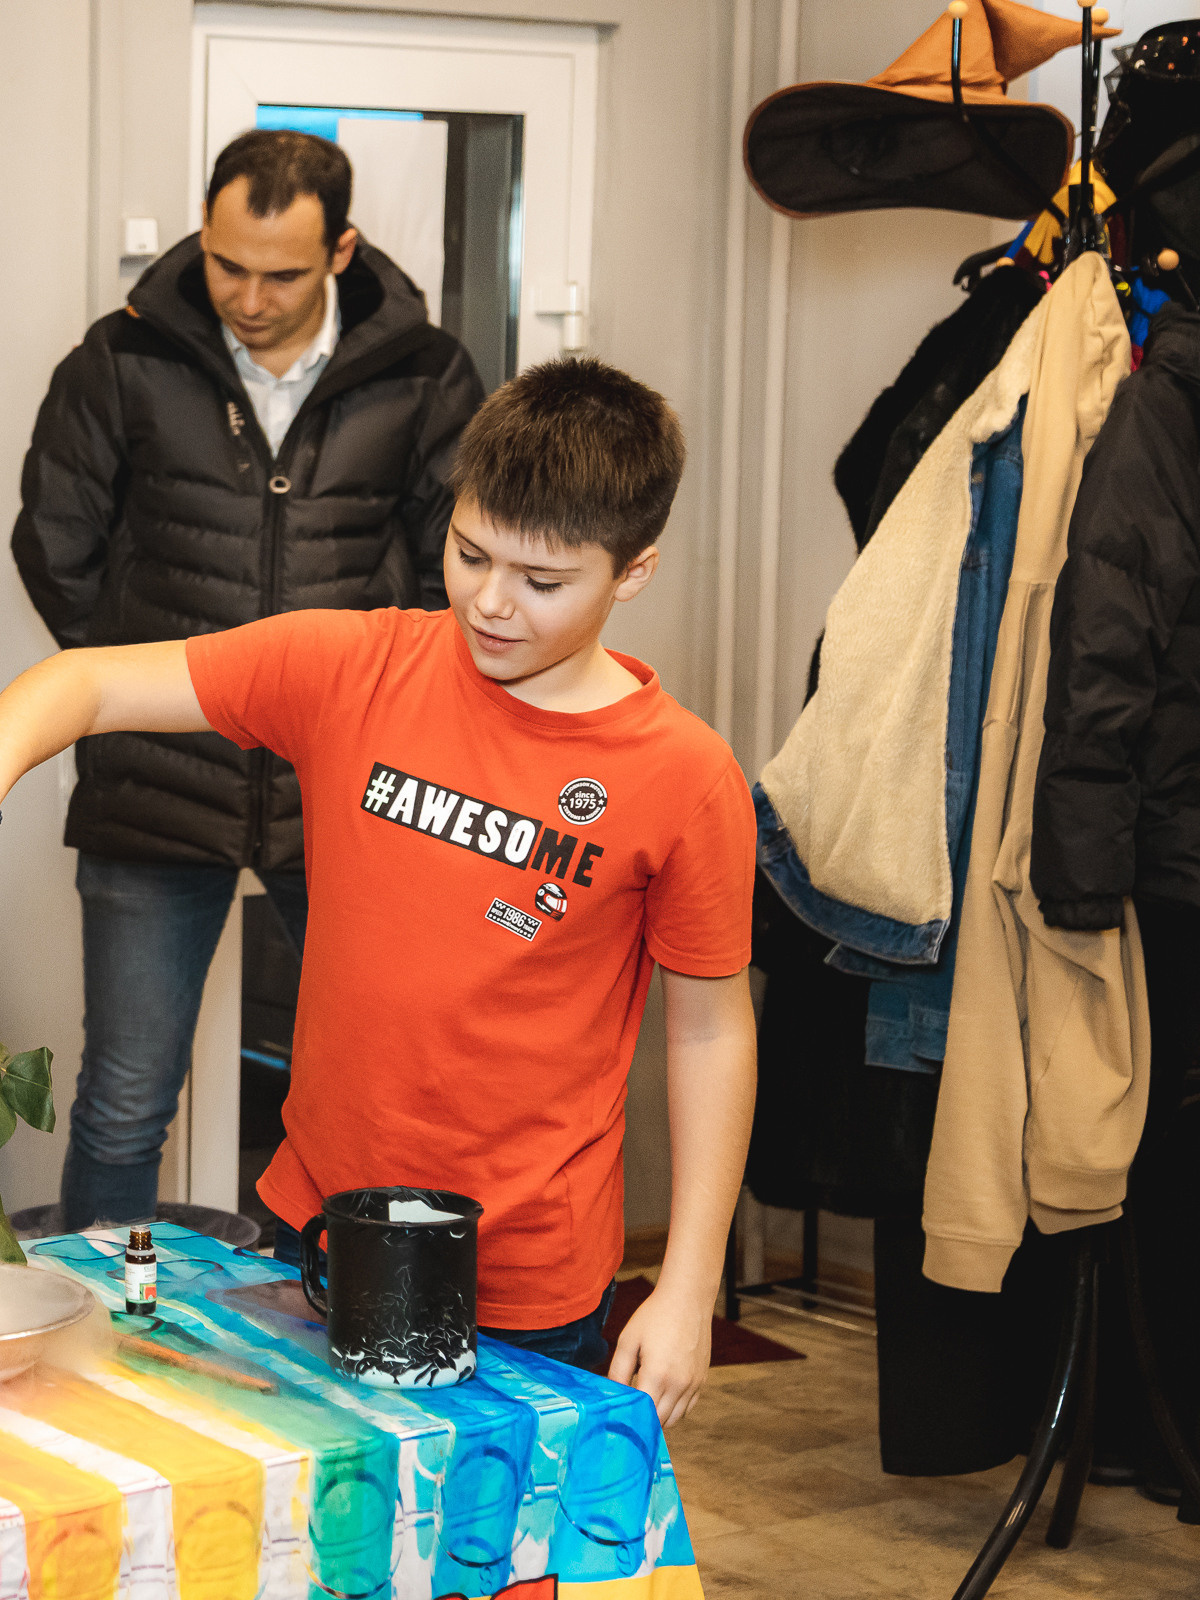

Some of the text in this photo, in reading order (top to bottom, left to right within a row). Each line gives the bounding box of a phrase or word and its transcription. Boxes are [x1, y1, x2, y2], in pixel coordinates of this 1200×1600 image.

[575, 791, 595, 799] since
[569, 798, 597, 809] 1975
[365, 770, 605, 888] #AWESOME
[503, 907, 527, 927] 1986
